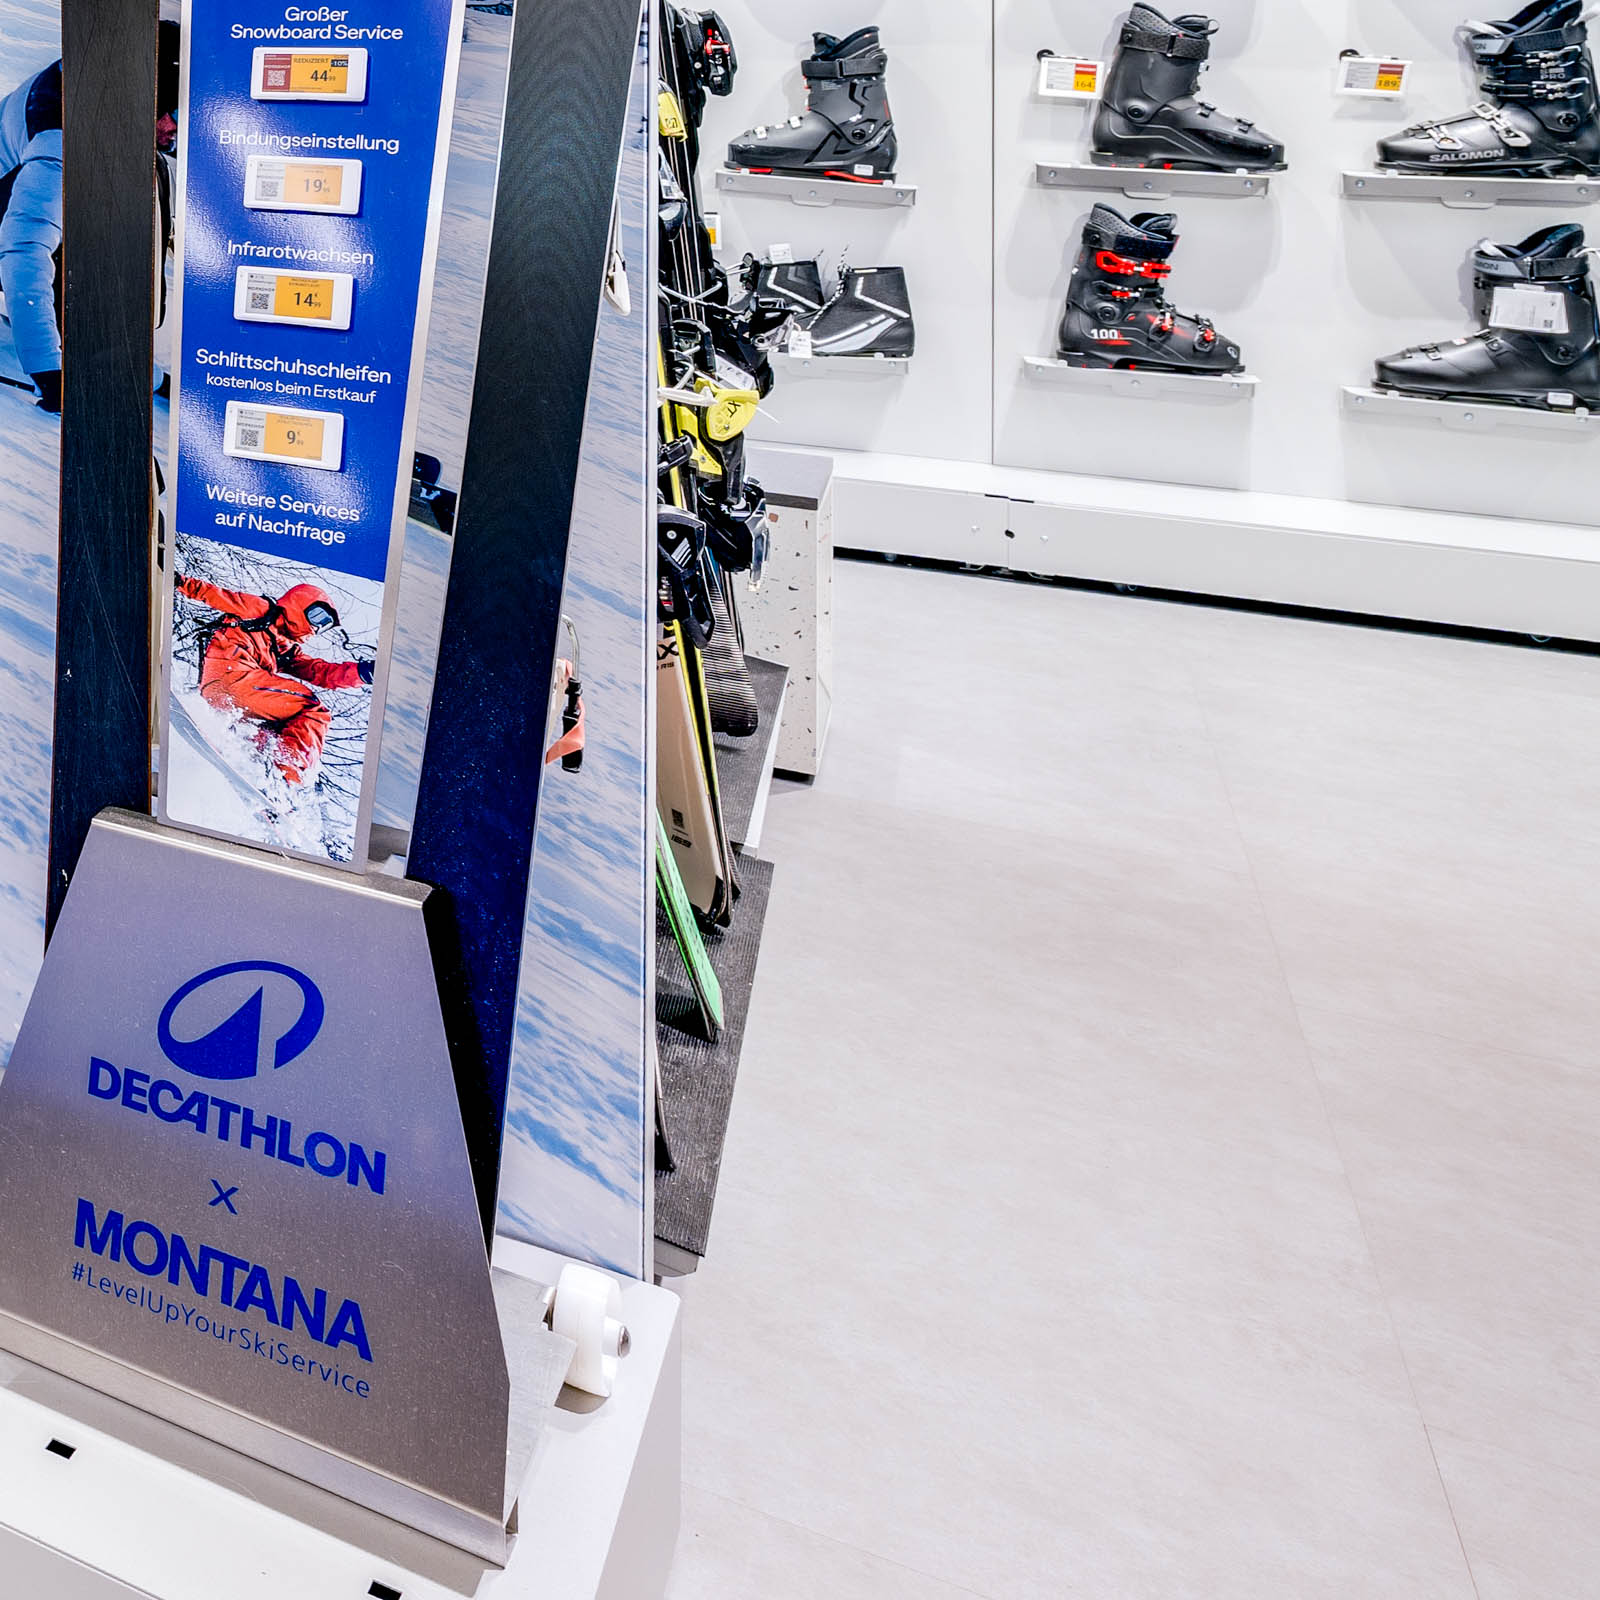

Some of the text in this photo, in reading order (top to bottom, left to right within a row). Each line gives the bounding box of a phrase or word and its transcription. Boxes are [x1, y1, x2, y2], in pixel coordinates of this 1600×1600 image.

[285, 6, 348, 22] Großer
[231, 24, 404, 41] Snowboard Service
[310, 70, 328, 82] 44
[219, 129, 399, 155] Bindungseinstellung
[1429, 149, 1505, 163] SALOMON
[228, 240, 374, 265] Infrarotwachsen
[294, 292, 313, 307] 14
[1090, 329, 1118, 339] 100
[195, 349, 391, 384] Schlittschuhschleifen
[206, 373, 376, 404] kostenlos beim Erstkauf
[286, 430, 296, 444] 9
[206, 483, 360, 522] Weitere Services
[215, 512, 346, 545] auf Nachfrage
[87, 1056, 386, 1195] DECATHLON
[73, 1198, 373, 1363] MONTANA
[71, 1261, 370, 1398] #LevelUpYourSkiService
